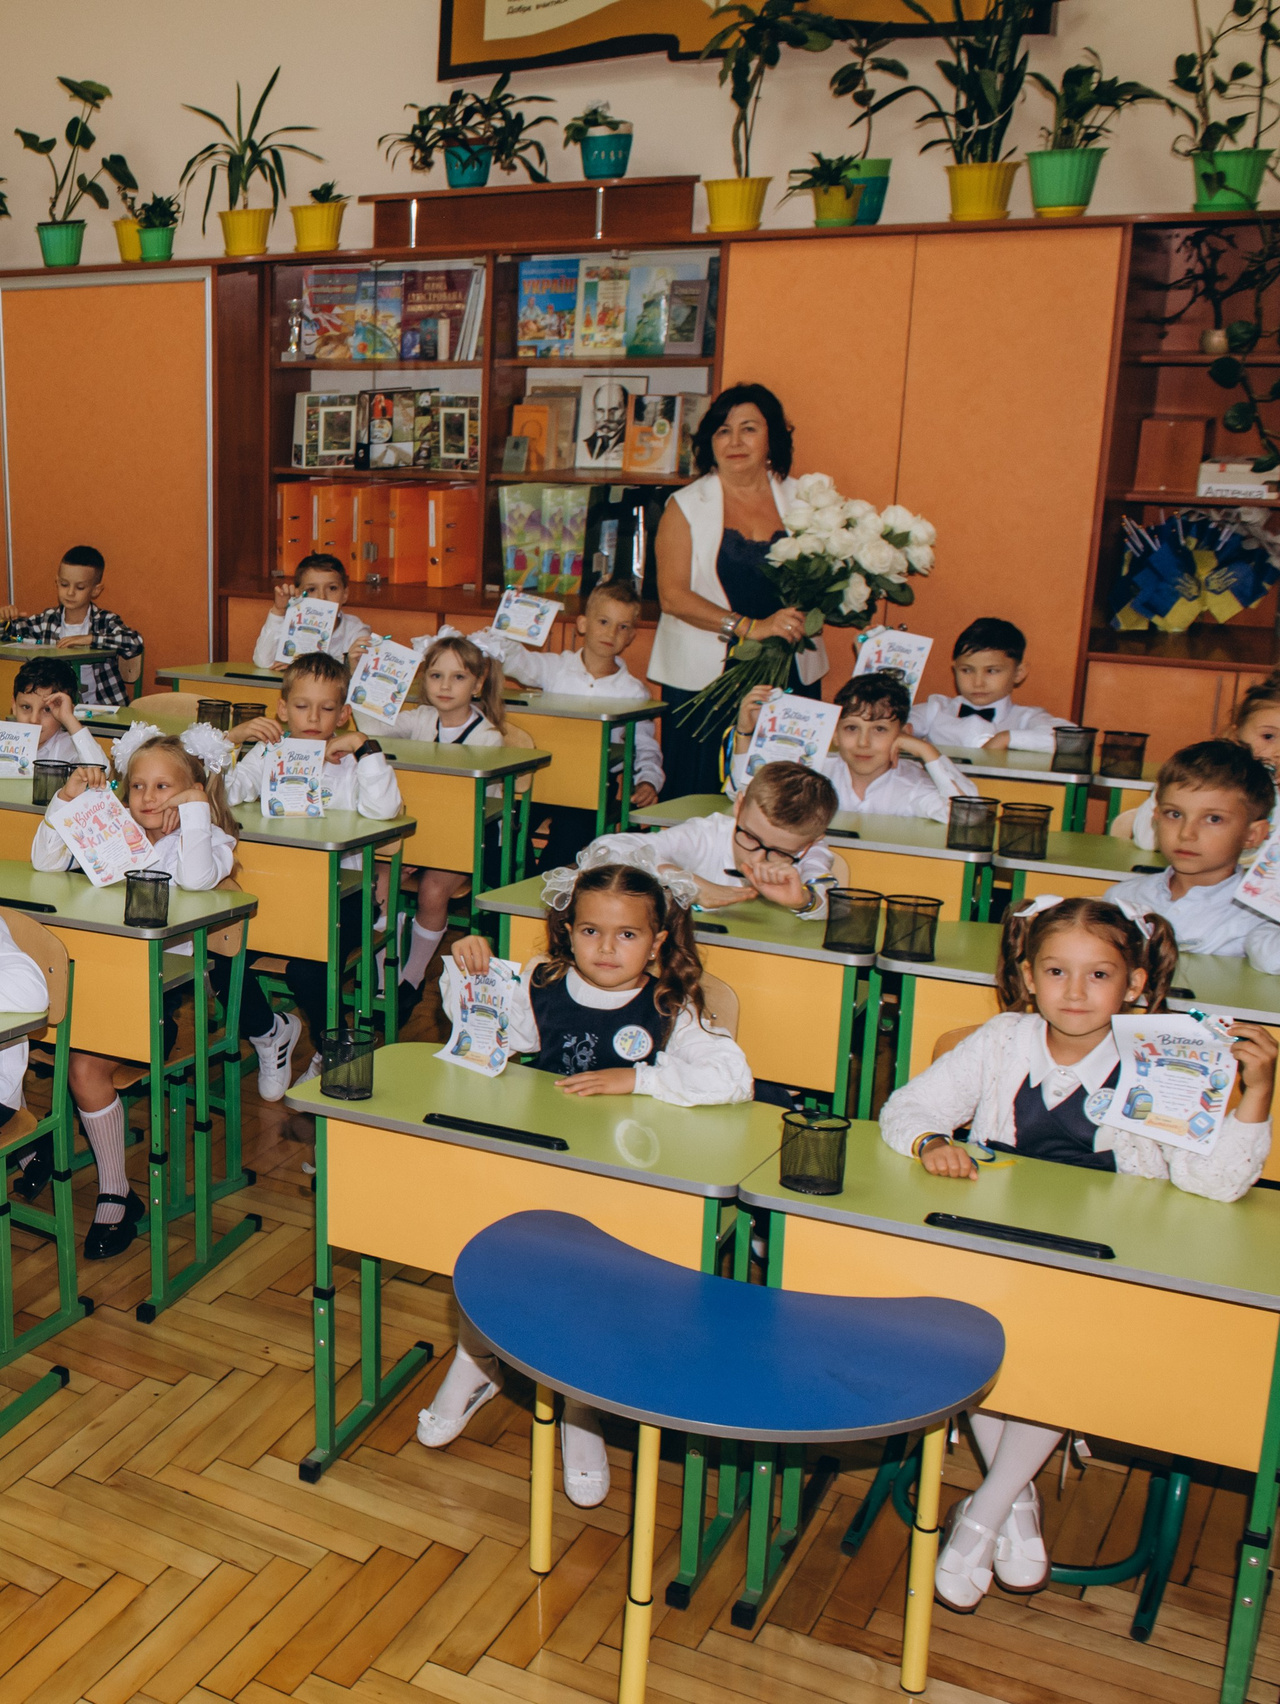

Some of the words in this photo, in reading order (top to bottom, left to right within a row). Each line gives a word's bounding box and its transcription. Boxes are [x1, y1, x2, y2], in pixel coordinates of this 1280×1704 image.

[522, 275, 578, 295] УКРАЇН
[296, 612, 303, 624] 1
[371, 657, 380, 671] 1
[875, 649, 883, 664] 1
[768, 716, 777, 732] 1
[276, 760, 285, 776] 1
[285, 766, 316, 776] КЛАСІ!
[73, 801, 106, 829] Вітаю
[92, 814, 107, 831] 1
[86, 818, 123, 848] КЛАСІ!
[464, 982, 475, 1002] 1
[474, 991, 504, 1009] КЛАСІ!
[1157, 1033, 1204, 1047] Вітаю
[1141, 1042, 1162, 1056] 1
[1162, 1048, 1222, 1066] КЛАСІ!
